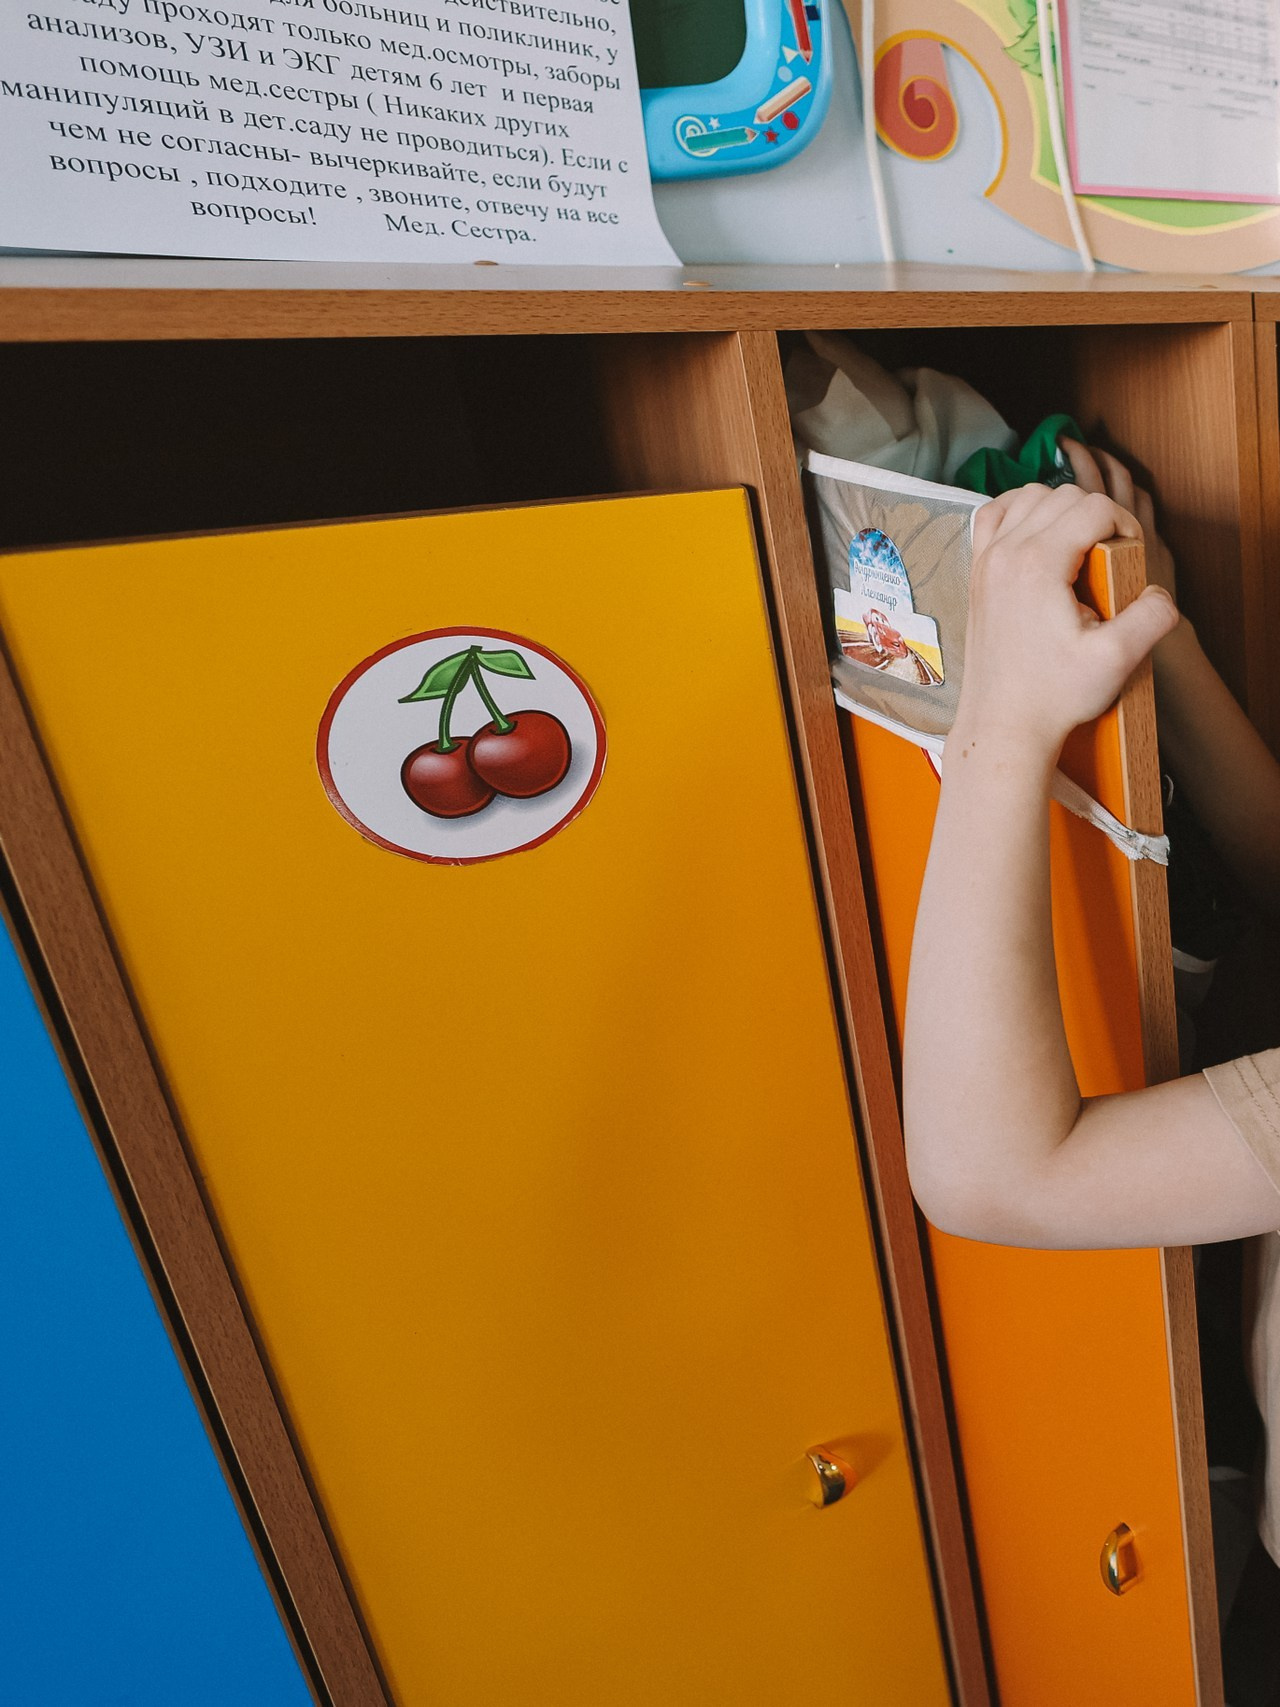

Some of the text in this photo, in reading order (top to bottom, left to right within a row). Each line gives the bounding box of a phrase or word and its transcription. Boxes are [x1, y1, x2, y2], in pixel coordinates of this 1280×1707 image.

[143, 0, 275, 34] проходят
[282, 21, 372, 50] только
[380, 37, 539, 79] мед.осмотры,
[544, 64, 620, 91] заборы
[322, 0, 430, 31] больниц
[436, 17, 451, 33] и
[458, 21, 601, 62] поликлиник,
[606, 47, 619, 65] у
[445, 0, 617, 36] ствительно,
[27, 12, 594, 114] анализов, УЗИ и ЭКГ детям 6 лет и первая
[78, 55, 200, 89] помощь
[208, 74, 359, 111] мед.сестры
[383, 93, 487, 127] Никаких
[494, 115, 570, 138] других
[0, 79, 629, 174] манипуляций в дет.саду не проводиться). Если с
[47, 120, 608, 201] чем не согласны- вычеркивайте, если будут
[48, 154, 181, 183] вопросы
[206, 170, 348, 199] подходите
[368, 187, 471, 214] звоните,
[476, 198, 549, 222] отвечу
[556, 206, 582, 222] на
[587, 210, 620, 226] все
[190, 201, 537, 245] вопросы! Мед. Сестра.
